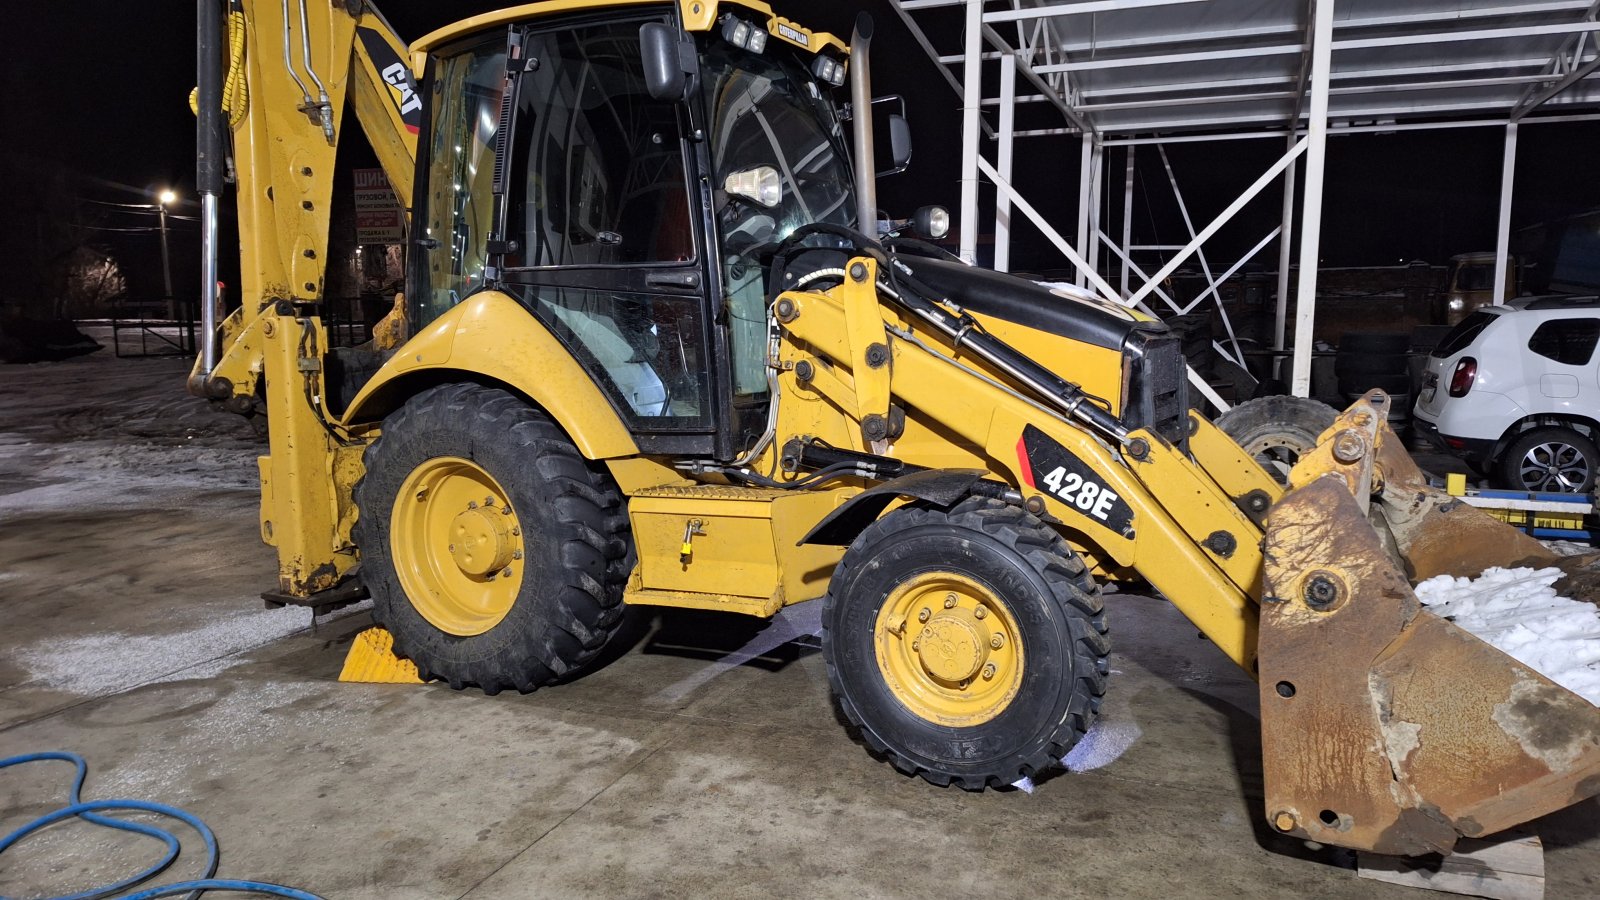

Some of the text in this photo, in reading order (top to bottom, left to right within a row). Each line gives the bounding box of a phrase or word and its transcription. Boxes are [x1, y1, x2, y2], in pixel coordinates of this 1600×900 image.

[779, 24, 807, 46] CATERPILLAR
[382, 62, 422, 115] CAT
[1043, 466, 1118, 520] 428E
